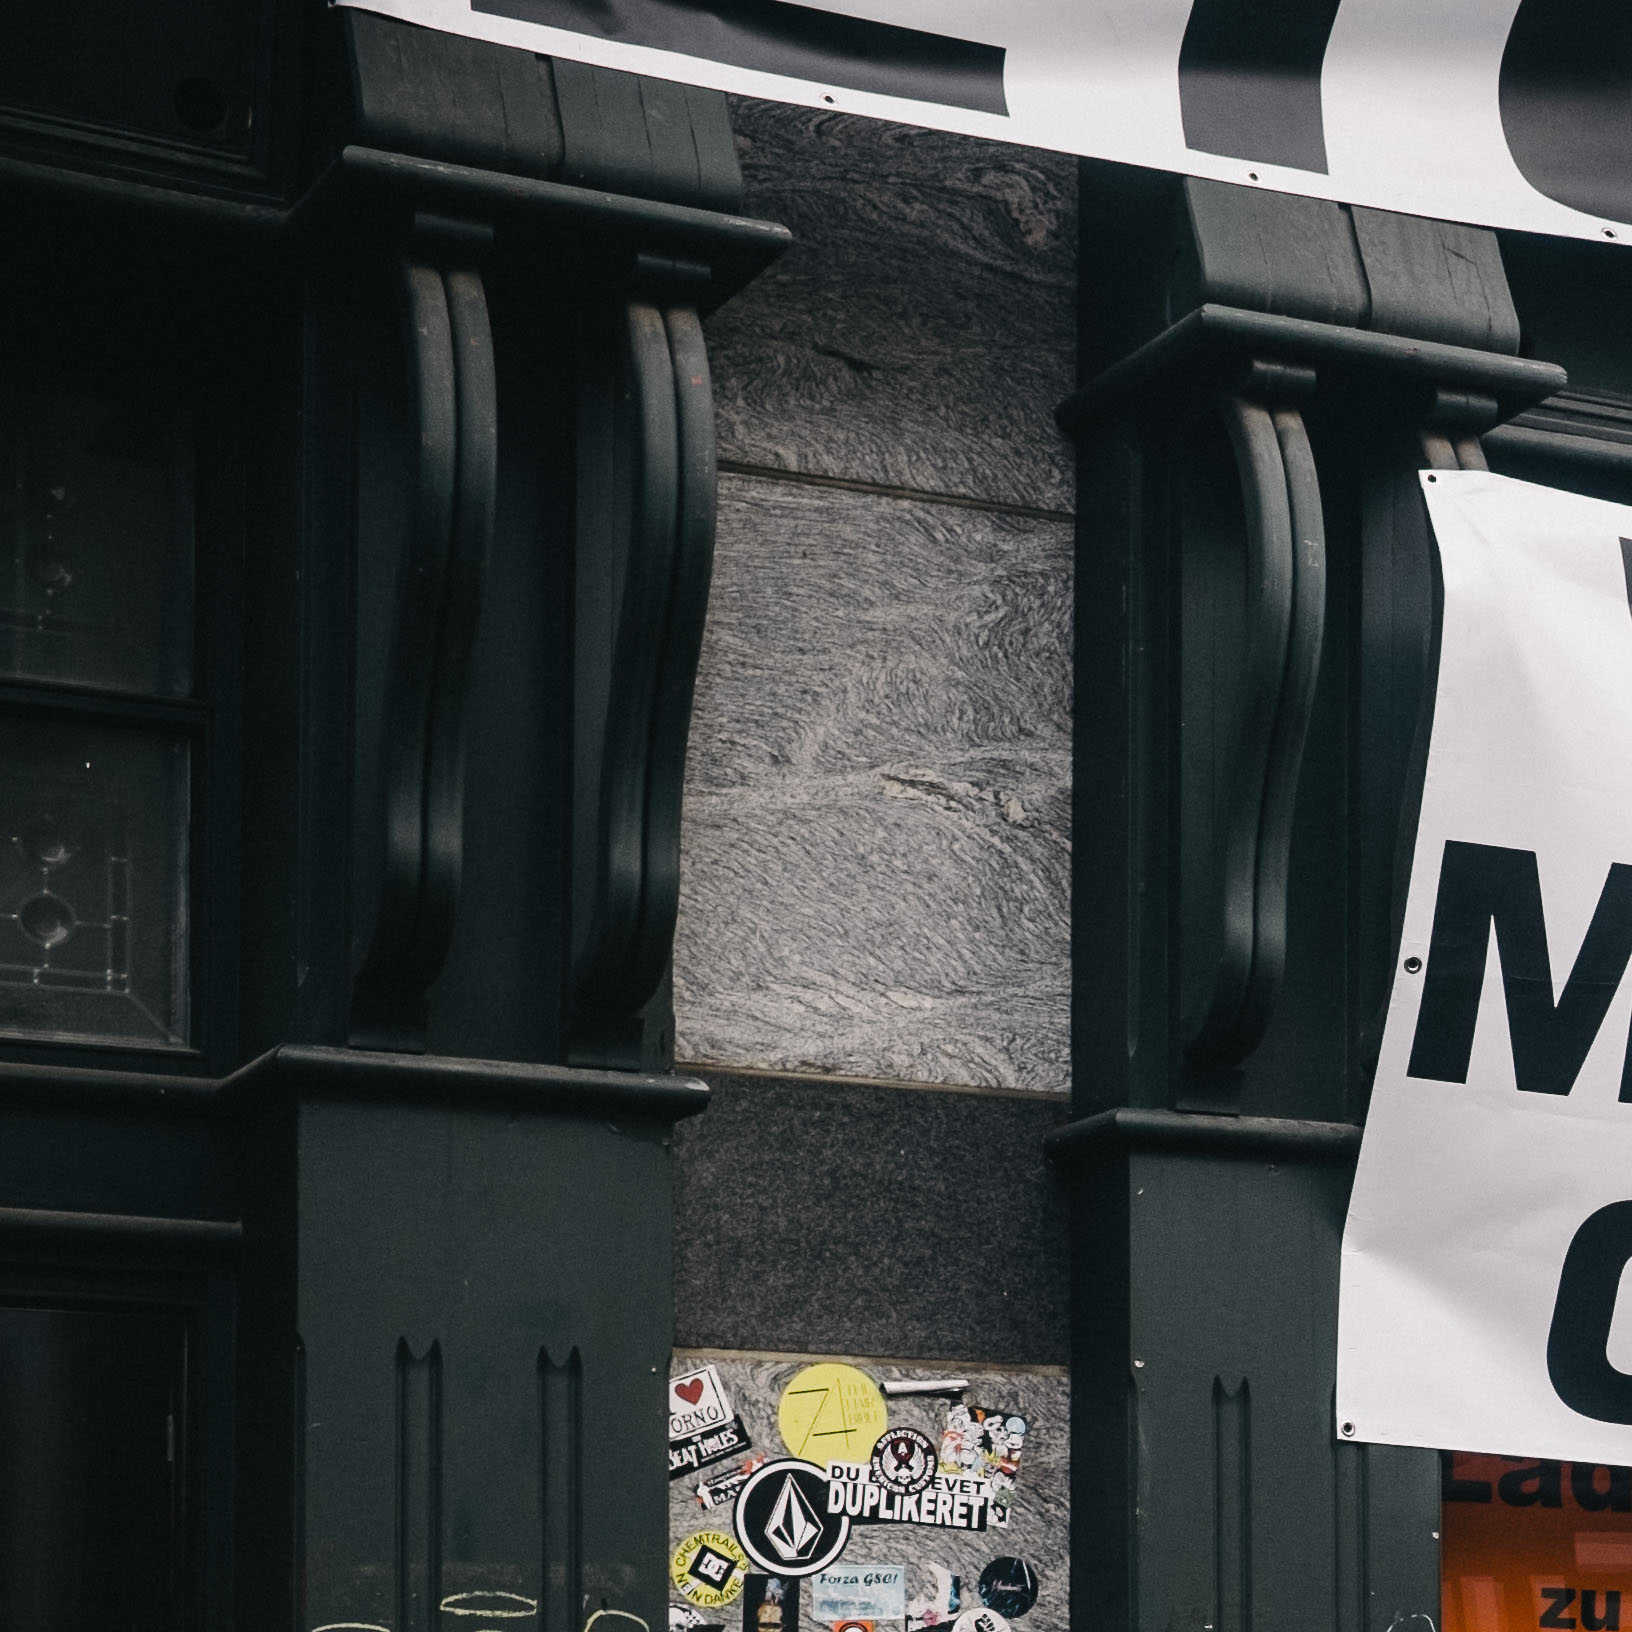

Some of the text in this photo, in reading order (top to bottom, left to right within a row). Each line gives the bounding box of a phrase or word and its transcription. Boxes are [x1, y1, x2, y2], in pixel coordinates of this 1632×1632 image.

[670, 1405, 719, 1434] ORNO
[831, 1465, 860, 1481] DU
[933, 1477, 986, 1495] EVET
[827, 1481, 986, 1529] DUPLIKERET
[819, 1573, 859, 1585] Forza
[1539, 1586, 1622, 1632] zu
